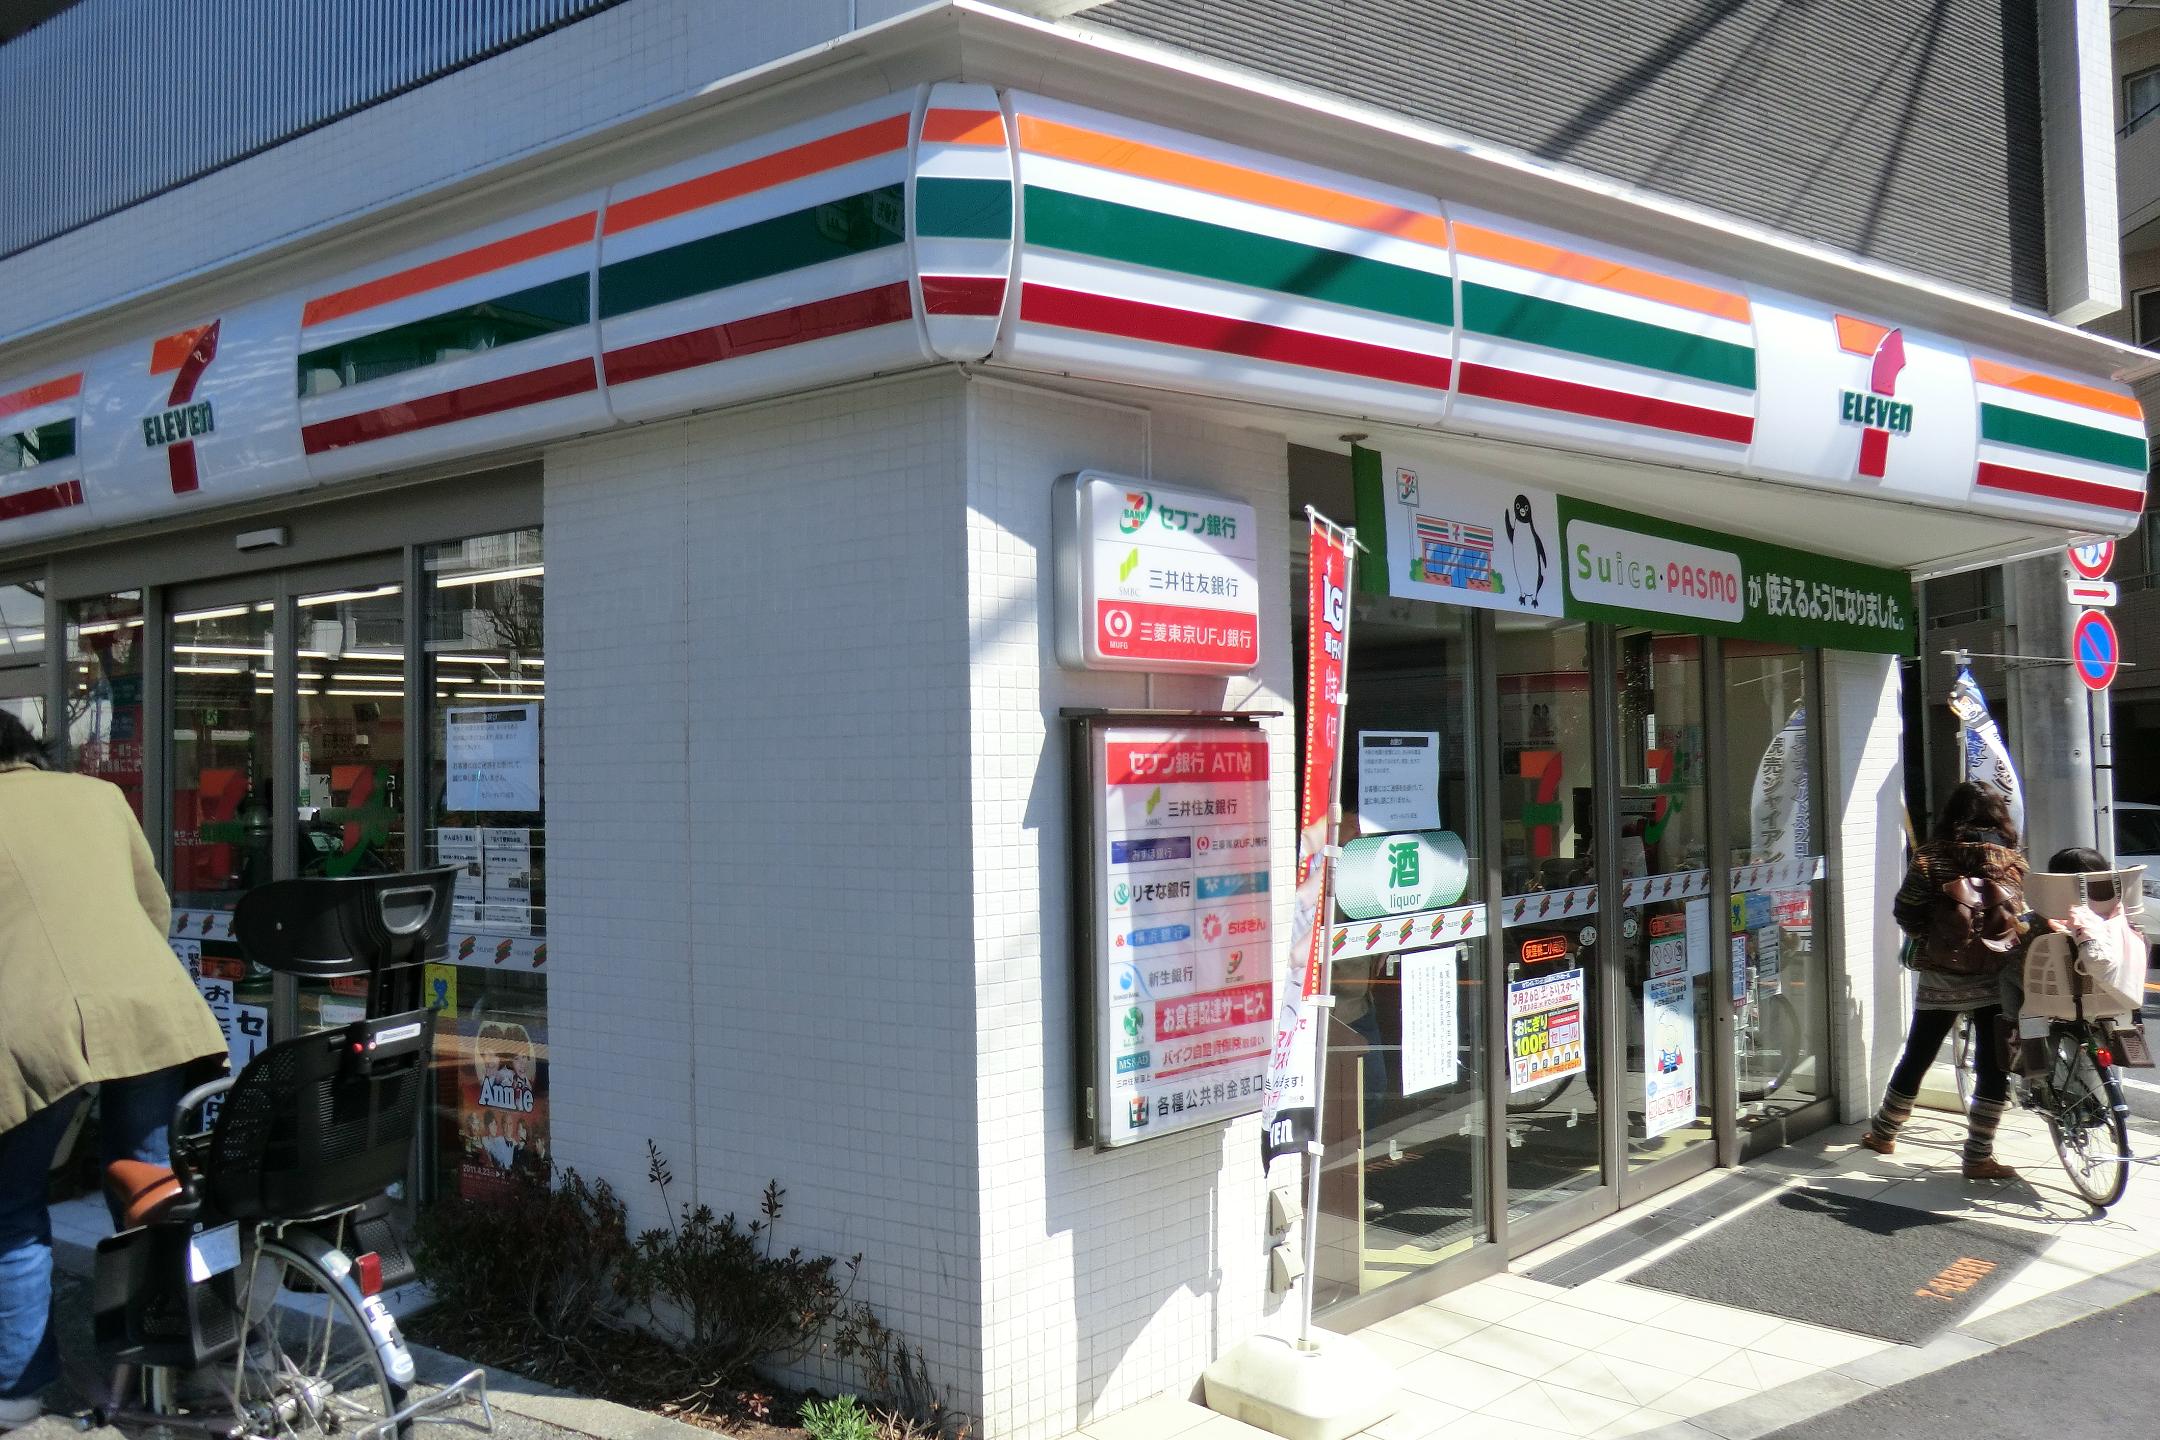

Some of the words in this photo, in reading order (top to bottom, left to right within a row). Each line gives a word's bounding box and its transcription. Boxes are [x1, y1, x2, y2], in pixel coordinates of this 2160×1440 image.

[1159, 504, 1237, 540] セブン銀行
[1149, 569, 1239, 598] 三井住友銀行
[1109, 640, 1129, 650] MUFG
[1140, 621, 1252, 649] 三菱東京UFJ銀行
[1129, 751, 1205, 775] セブン銀行
[1212, 752, 1252, 773] ATM
[1168, 799, 1238, 817] 三井住友銀行
[1388, 841, 1420, 889] 酒
[1133, 881, 1191, 902] りそな銀行
[1390, 893, 1422, 910] liquor
[1149, 966, 1193, 987] 新生銀行
[1163, 991, 1265, 1033] お食事配達サービス
[1515, 1014, 1548, 1036] おにぎり
[1550, 1023, 1578, 1044] セール
[1516, 1031, 1548, 1056] 100円
[478, 1075, 535, 1113] Annie
[1157, 1074, 1263, 1118] 各種公共料金窓口
